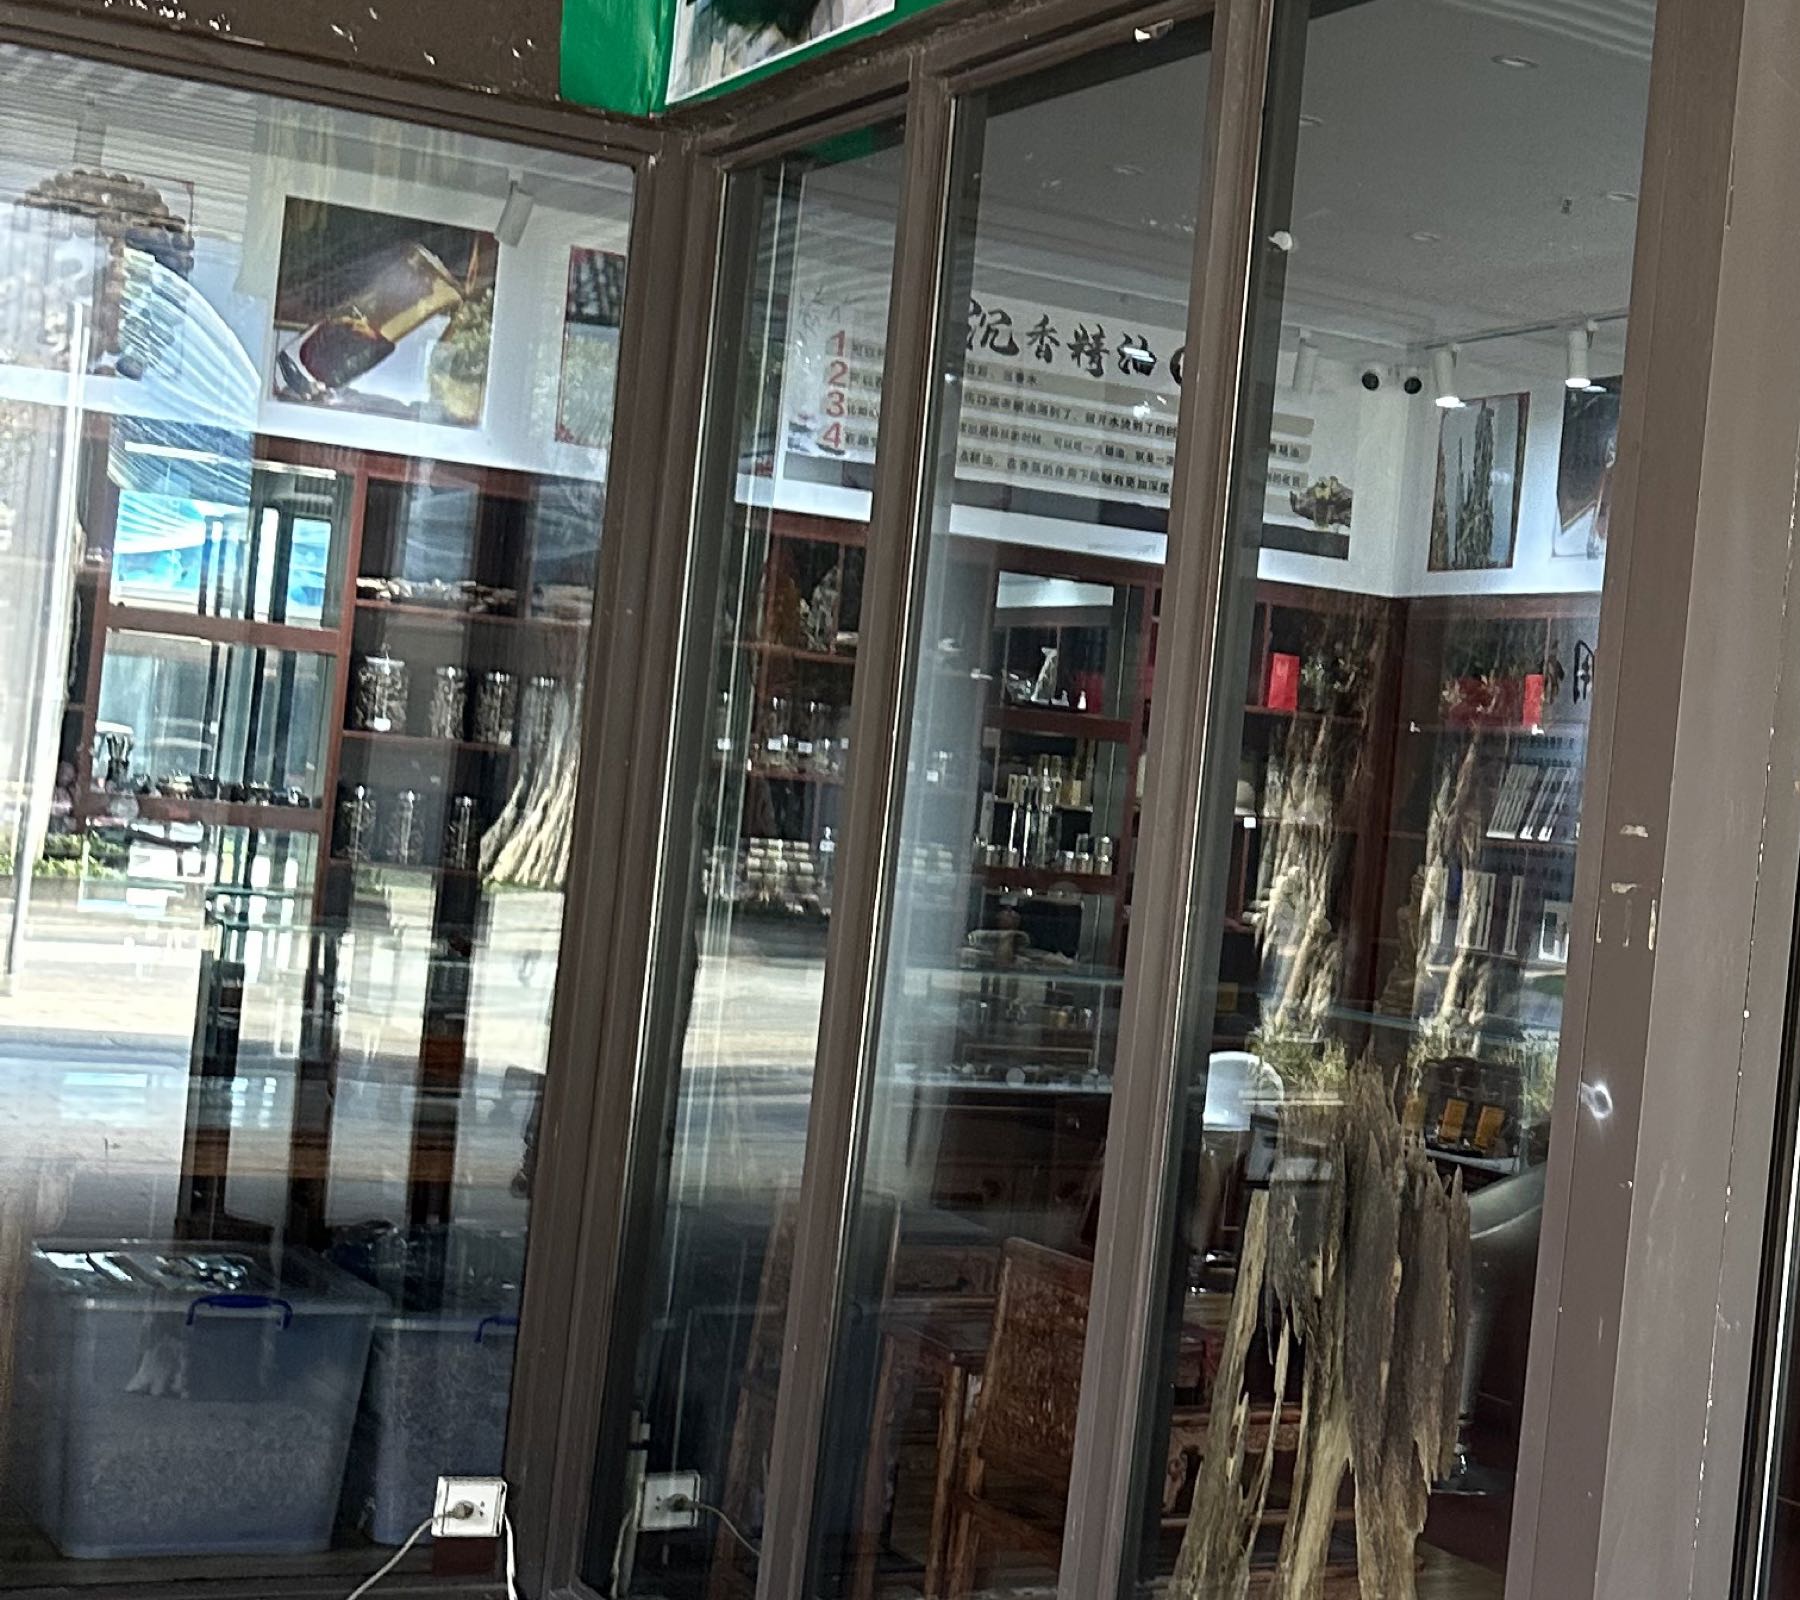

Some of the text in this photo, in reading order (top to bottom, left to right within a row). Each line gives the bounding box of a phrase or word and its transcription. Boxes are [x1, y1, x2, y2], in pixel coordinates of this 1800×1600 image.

[830, 330, 846, 357] 1
[827, 360, 849, 389] 2
[826, 391, 845, 418] 3
[823, 421, 843, 449] 4
